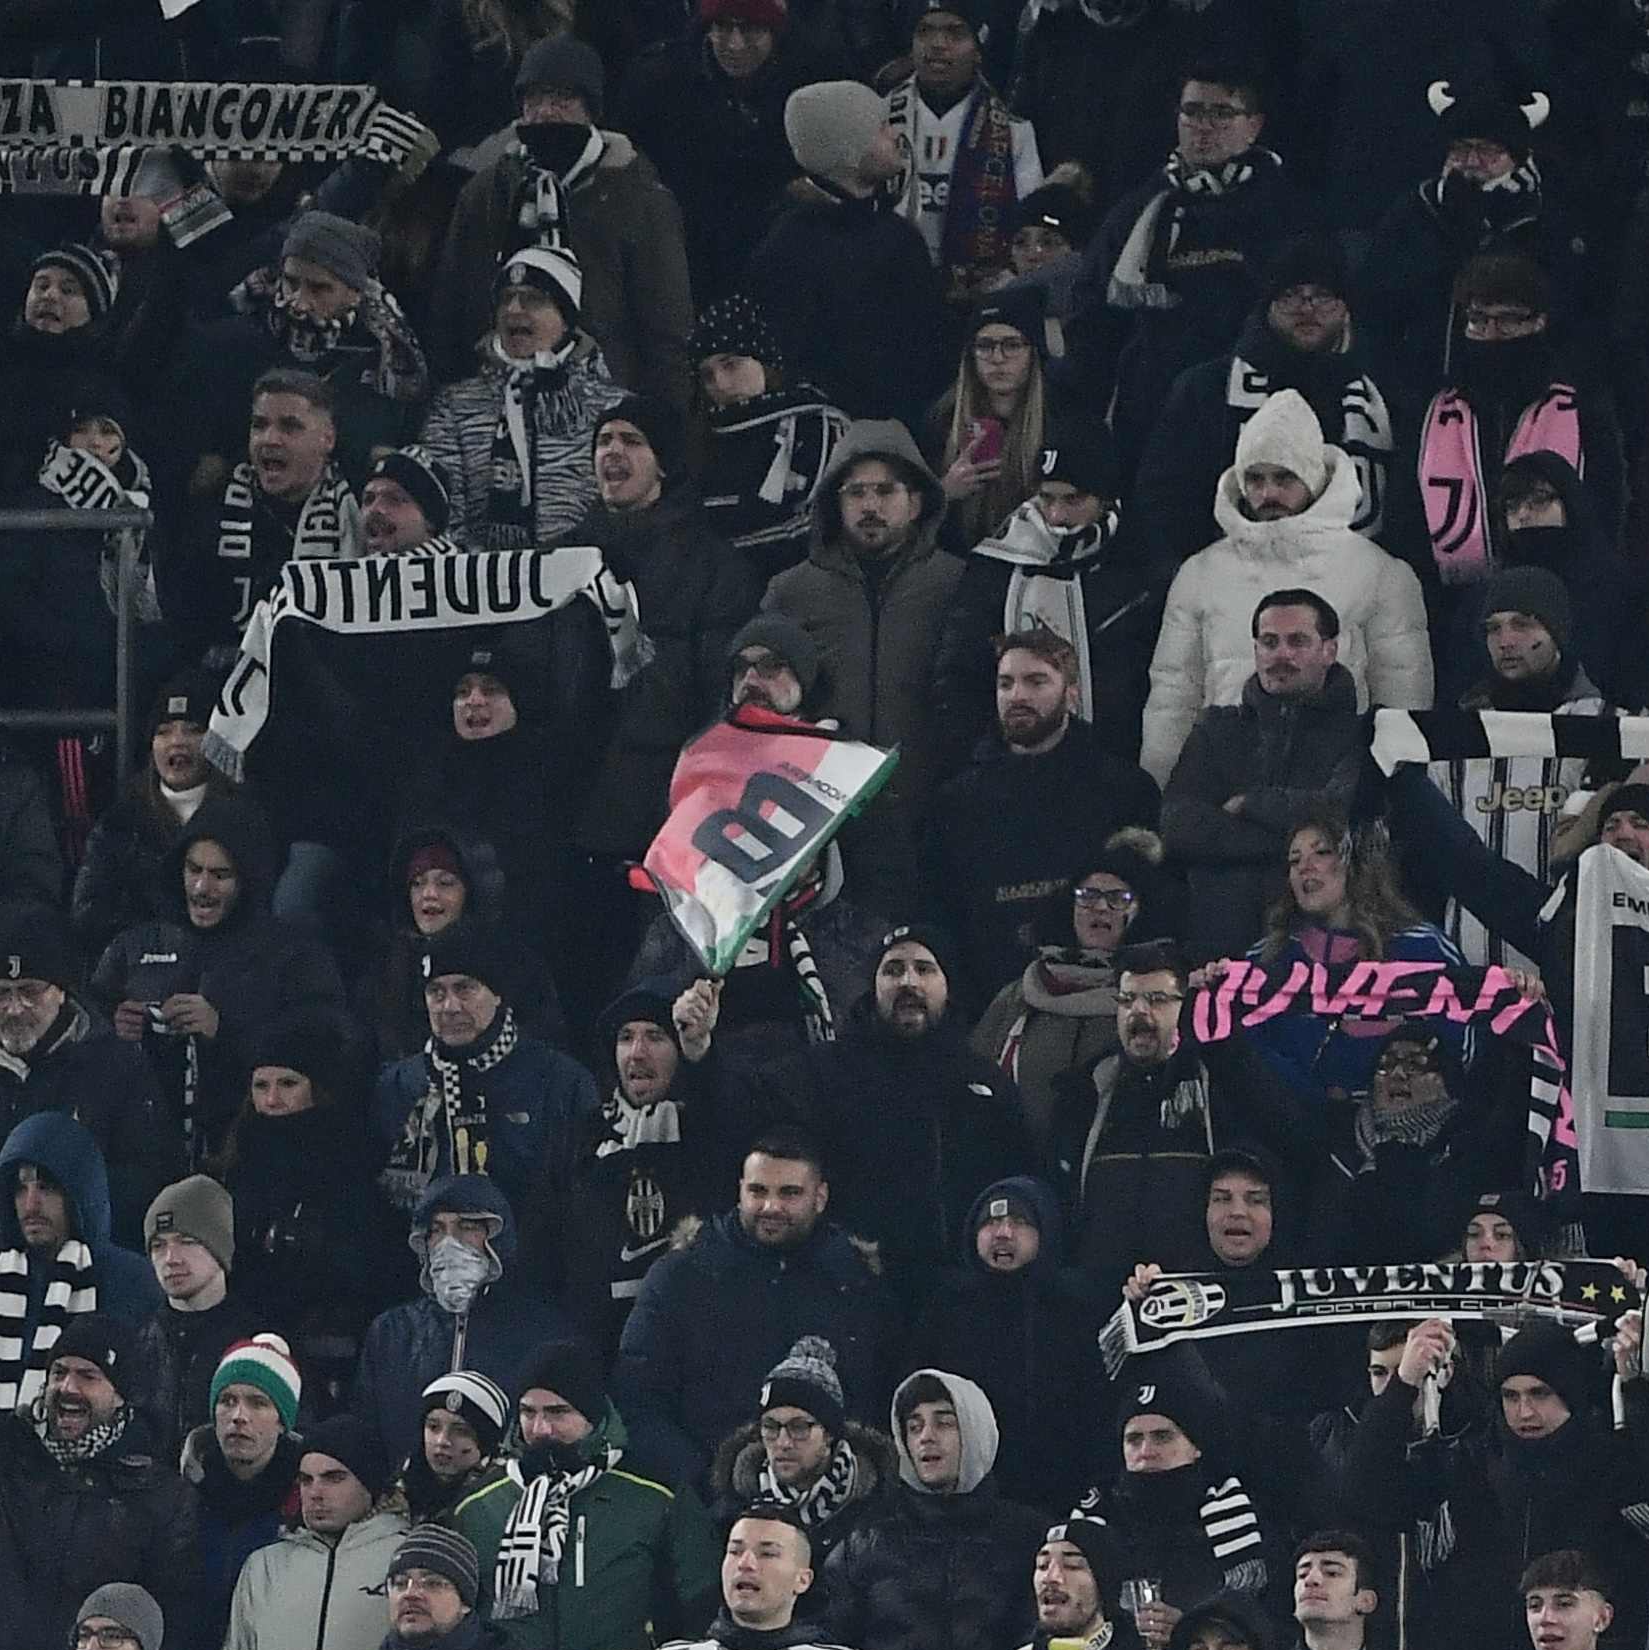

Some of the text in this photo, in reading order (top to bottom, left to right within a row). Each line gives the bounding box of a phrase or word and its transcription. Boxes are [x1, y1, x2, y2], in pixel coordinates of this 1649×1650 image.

[104, 83, 378, 142] BIANCONERI
[1475, 783, 1567, 814] Jeep
[1271, 1257, 1568, 1312] JUVENTUS
